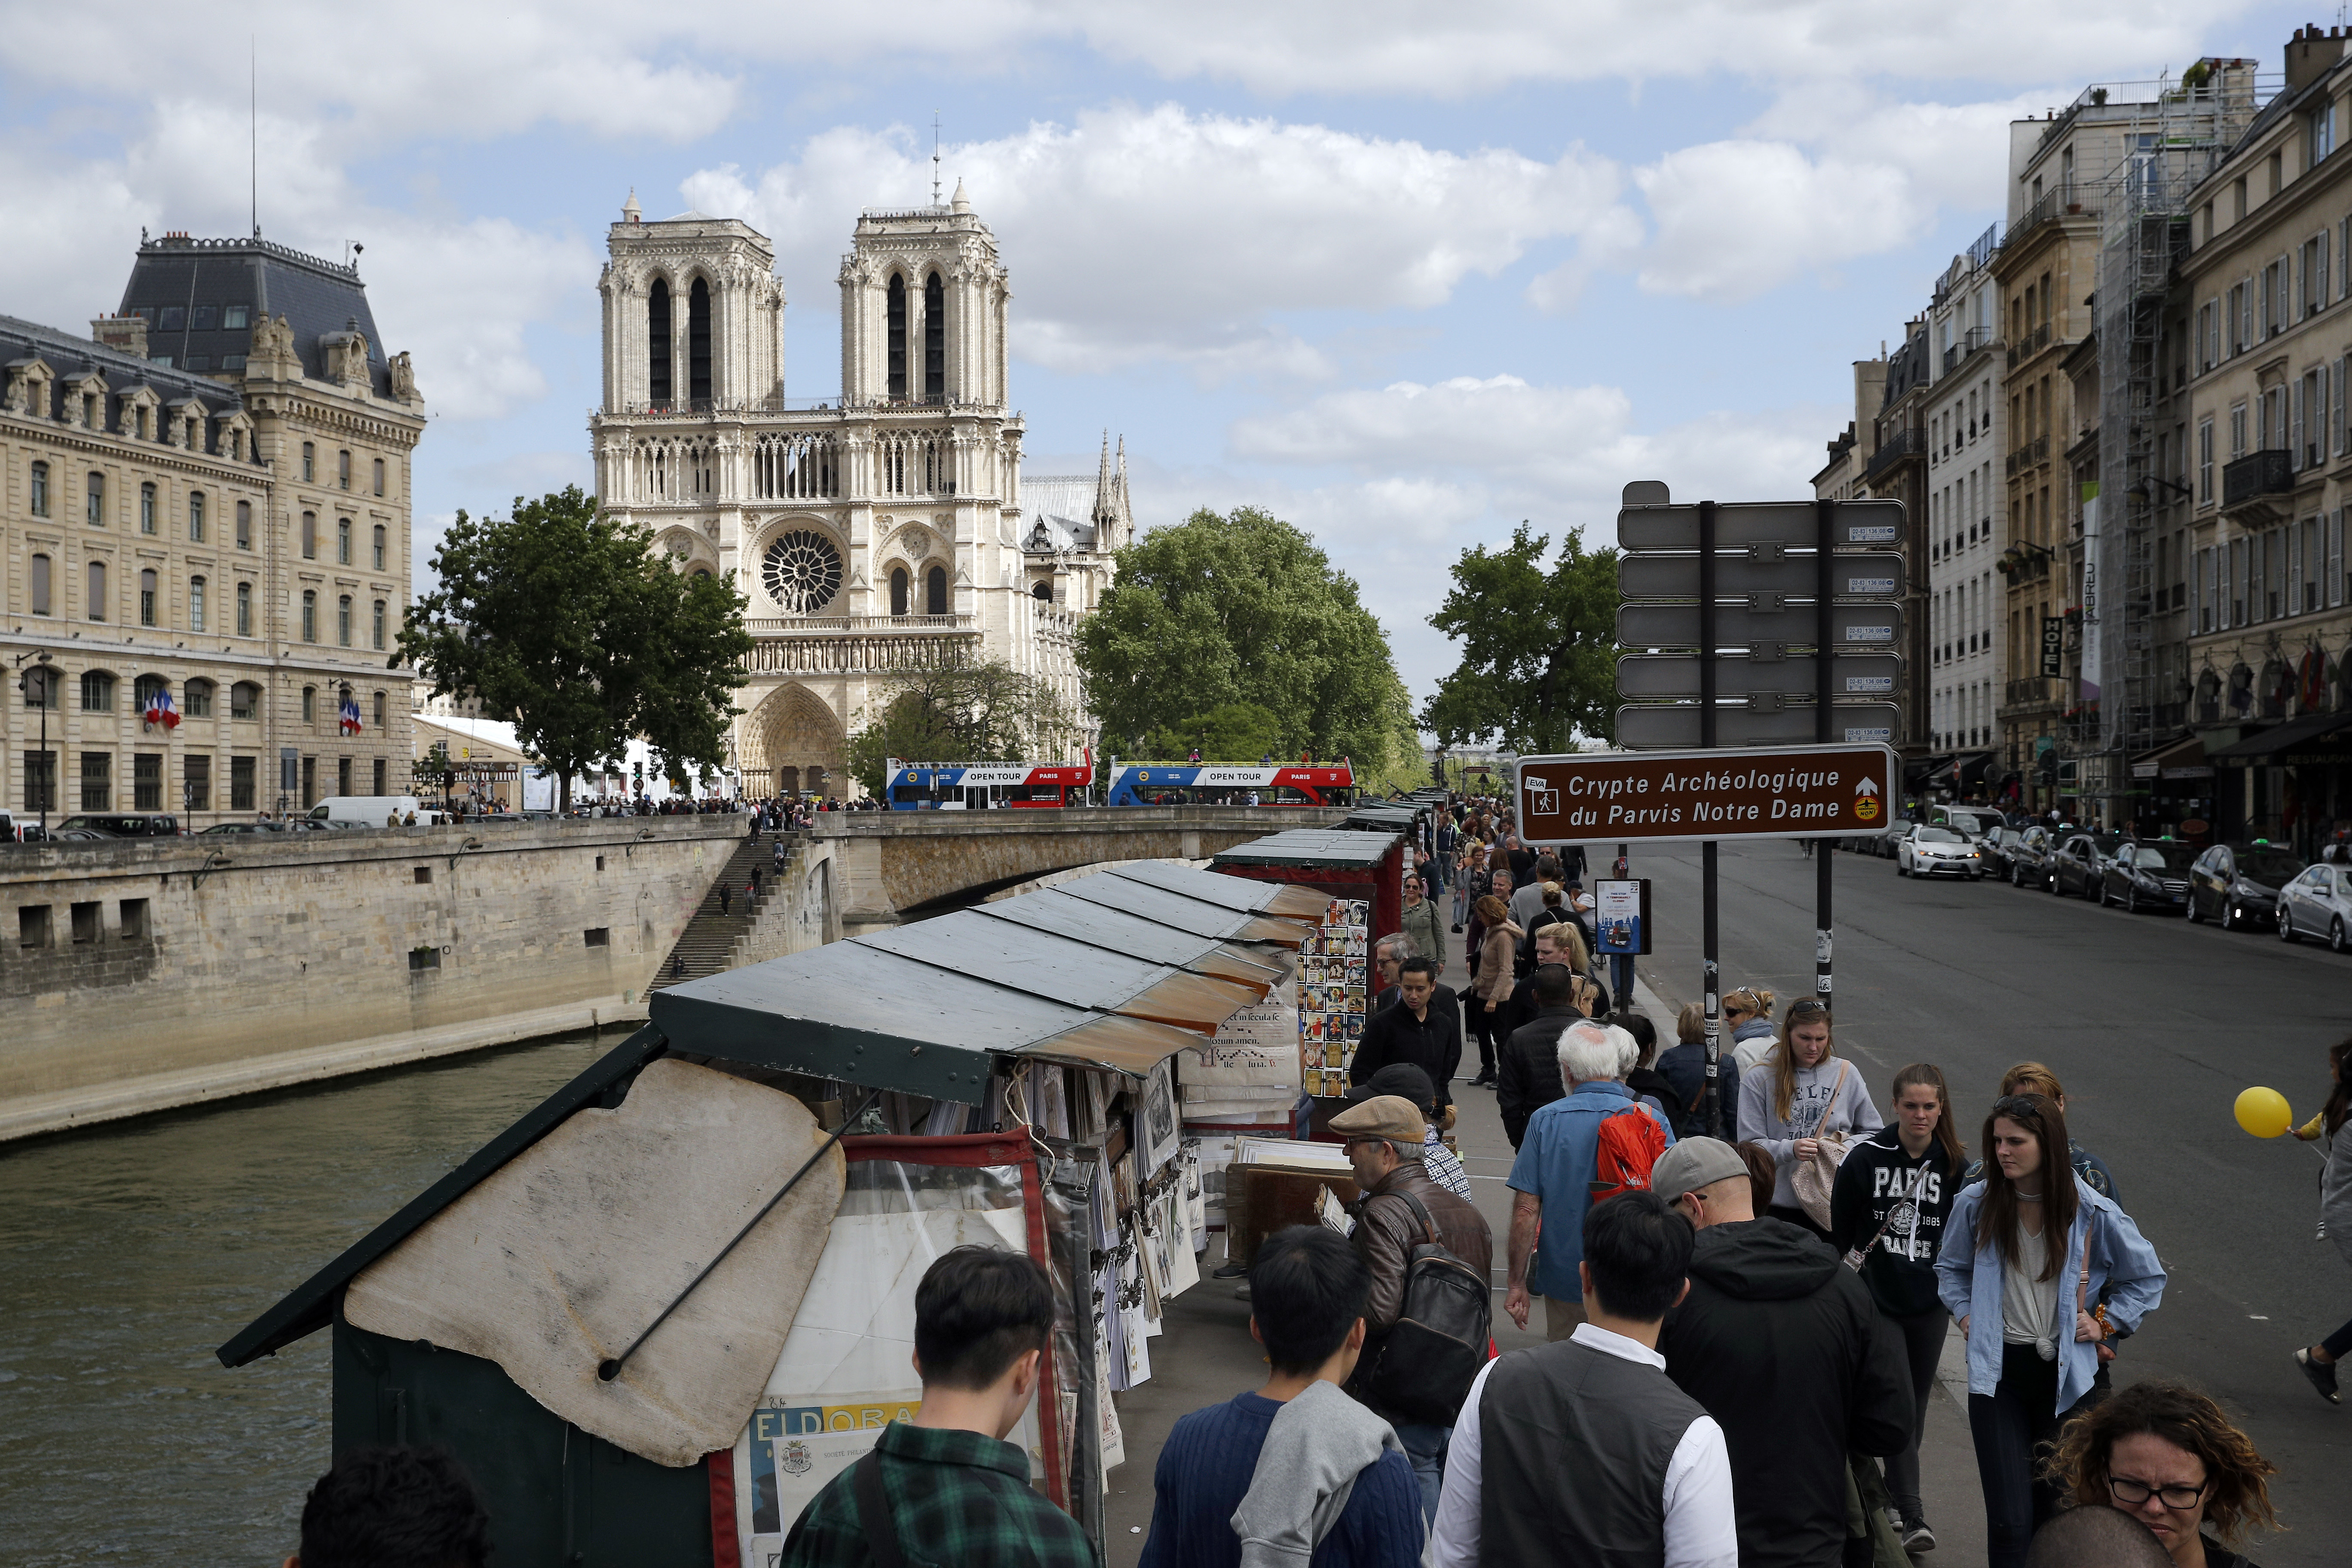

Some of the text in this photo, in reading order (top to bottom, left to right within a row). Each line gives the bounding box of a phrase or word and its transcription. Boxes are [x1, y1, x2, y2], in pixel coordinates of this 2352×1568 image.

[2043, 620, 2060, 675] HOTEL
[1530, 779, 1544, 787] EVA
[1568, 768, 1839, 799] Crypte Archéologique
[1570, 806, 1597, 826] du
[1608, 803, 1681, 824] Parvis
[1693, 802, 1759, 821] Notre
[1770, 799, 1839, 818] Dame
[1873, 1167, 1941, 1204] PARIS
[1873, 1209, 1885, 1220] ST.
[1880, 1235, 1932, 1258] RANCE
